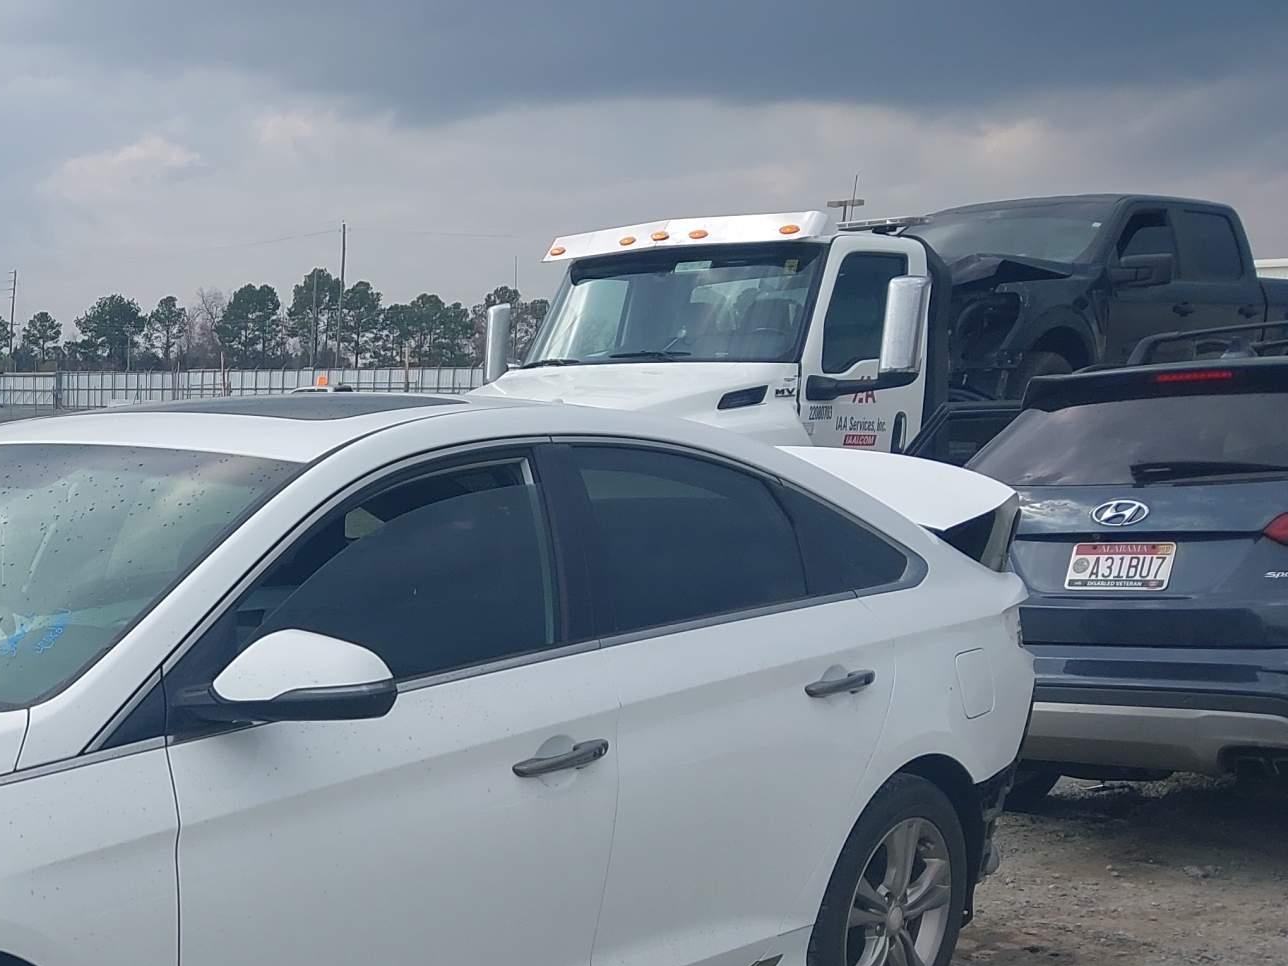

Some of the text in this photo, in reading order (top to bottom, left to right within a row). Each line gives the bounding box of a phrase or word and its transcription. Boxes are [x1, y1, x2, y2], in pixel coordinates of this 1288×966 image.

[775, 387, 795, 395] MV
[835, 416, 887, 432] IAA Services, Inc.
[1099, 544, 1148, 553] ALABAMA
[1088, 556, 1167, 579] A31BU7
